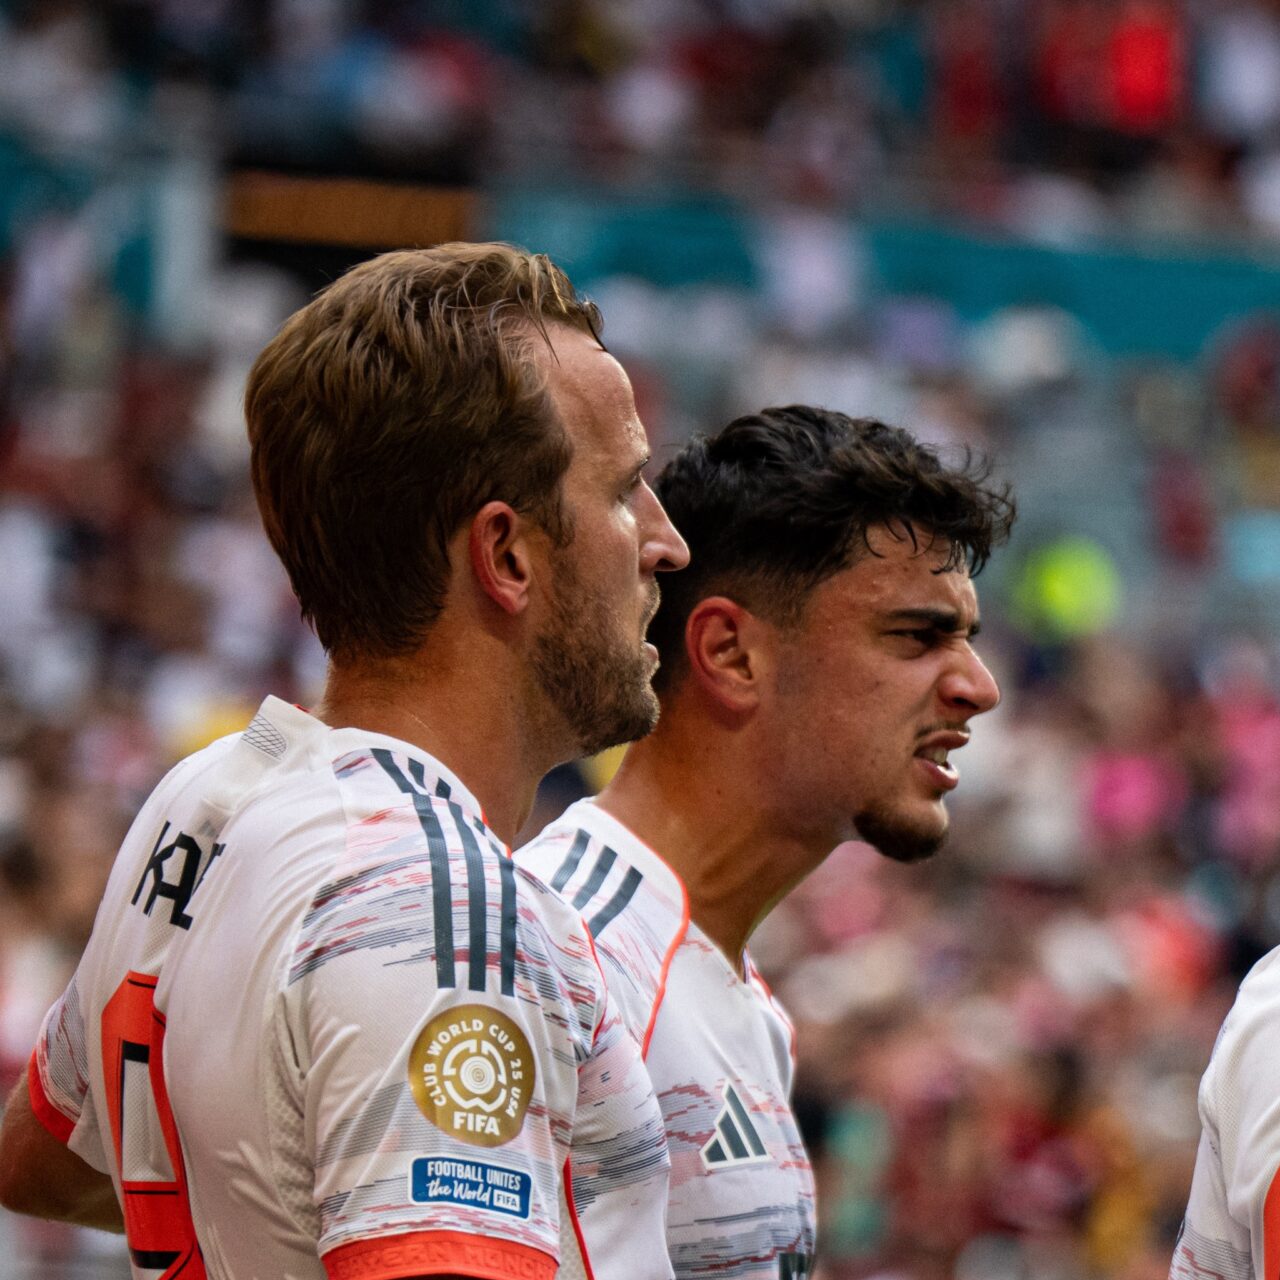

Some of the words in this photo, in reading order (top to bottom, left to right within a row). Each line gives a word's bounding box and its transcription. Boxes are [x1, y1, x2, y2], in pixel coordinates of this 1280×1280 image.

[427, 1019, 484, 1056] WORLD
[488, 1023, 516, 1053] CUP
[423, 1062, 447, 1107] CLUB
[510, 1058, 523, 1080] 25
[505, 1086, 522, 1118] USA
[453, 1111, 501, 1137] FIFA
[427, 1160, 485, 1183] FOOTBALL
[486, 1168, 522, 1191] UNITES
[426, 1178, 453, 1198] the
[453, 1180, 492, 1207] World
[496, 1193, 518, 1209] FIFA
